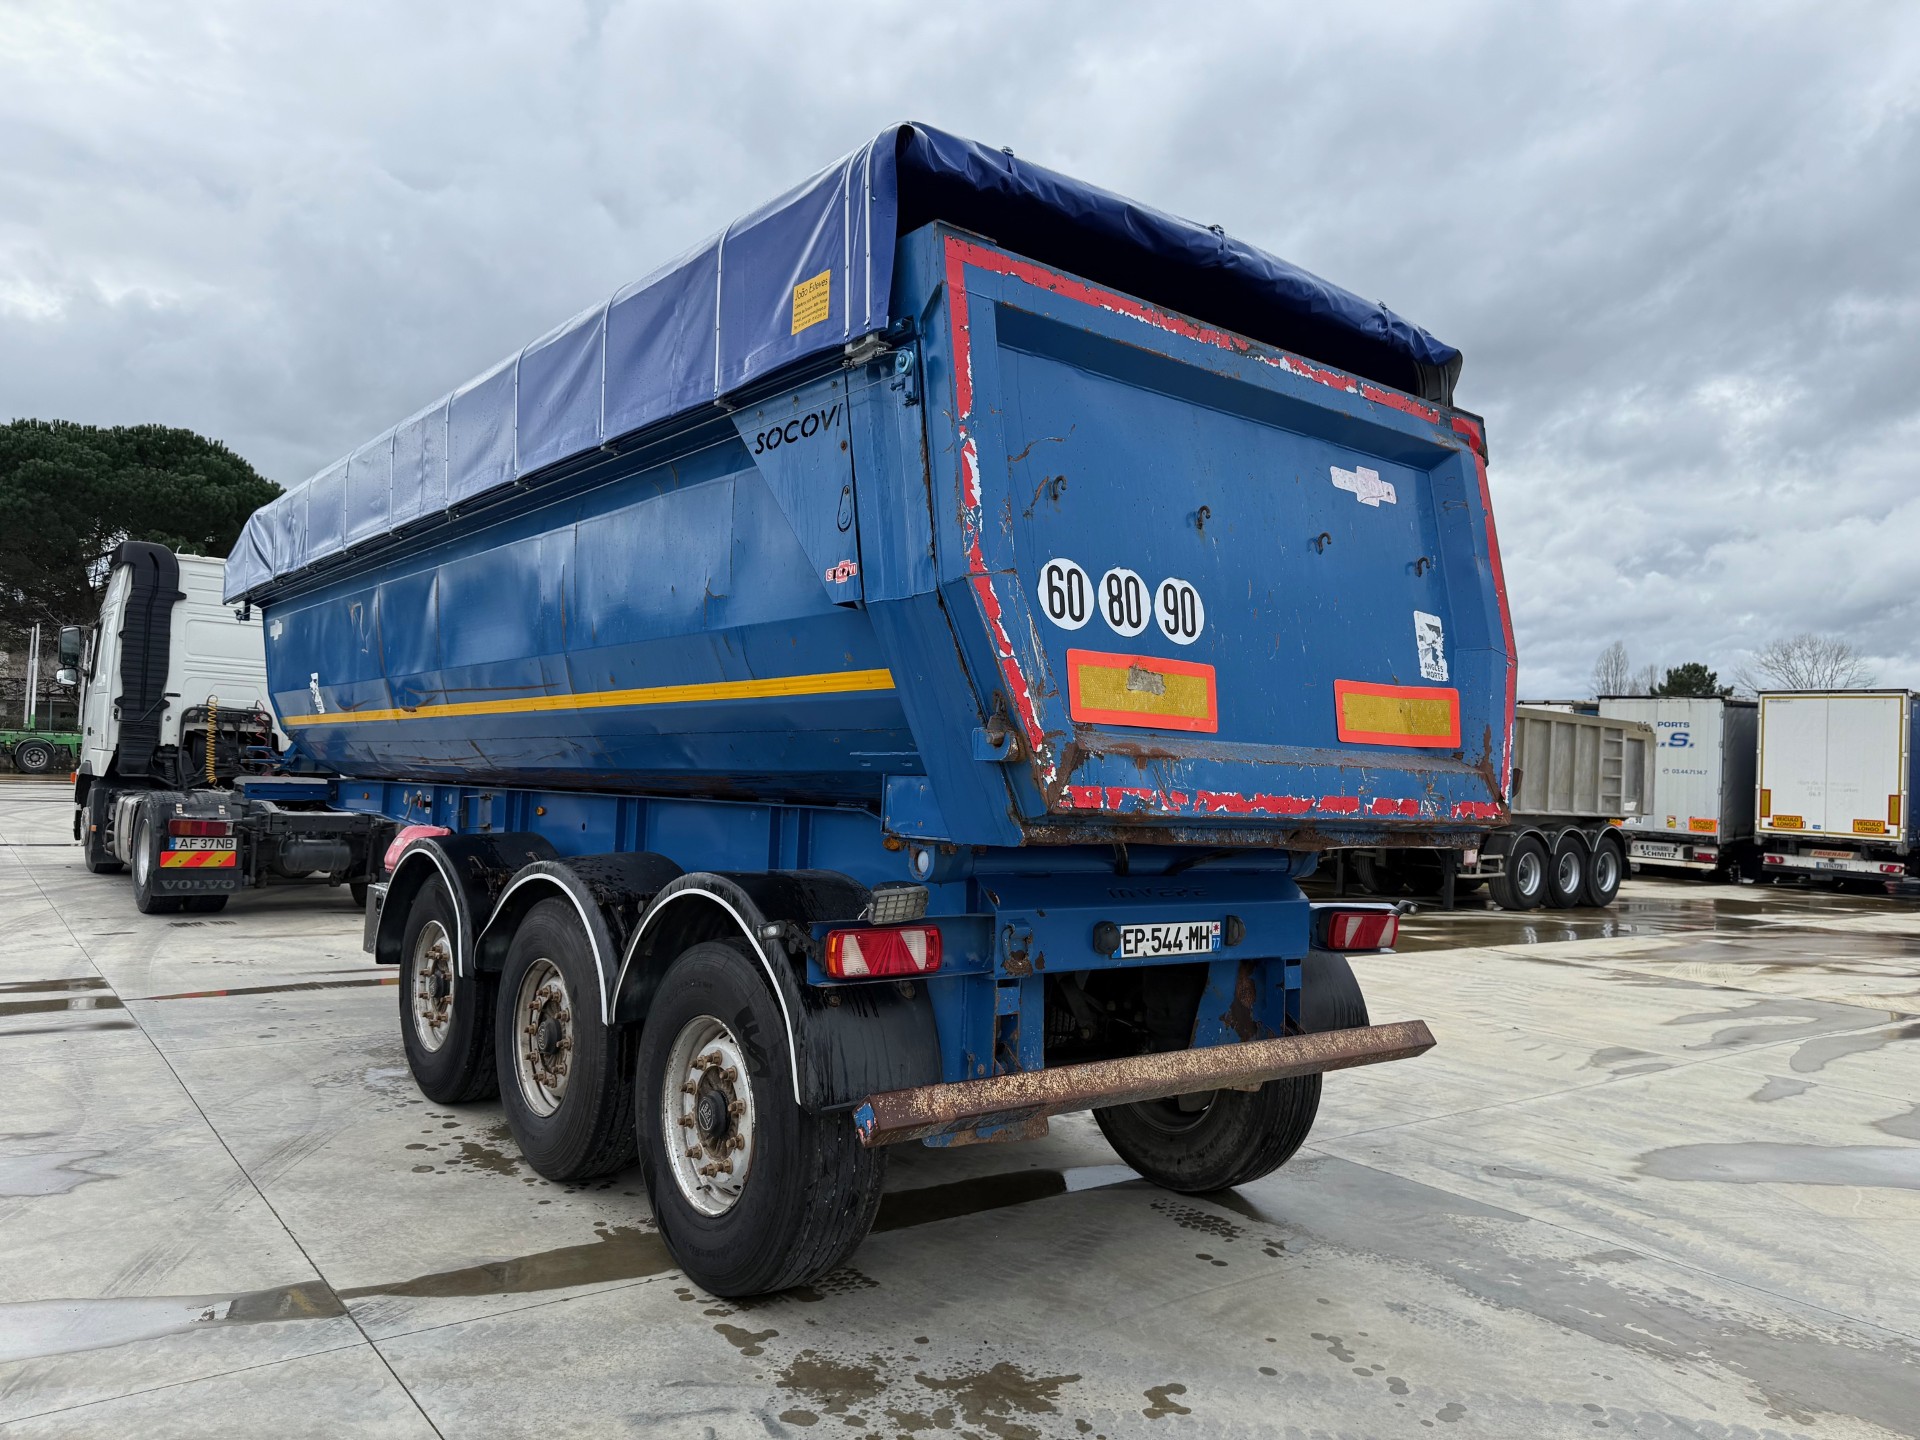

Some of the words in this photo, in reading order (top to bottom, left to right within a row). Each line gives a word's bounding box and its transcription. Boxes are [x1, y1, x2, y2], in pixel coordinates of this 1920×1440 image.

[755, 402, 843, 455] SOCOVI
[827, 564, 856, 580] SCOVI
[1047, 564, 1085, 622] 60
[1106, 573, 1142, 629] 80
[1162, 583, 1197, 638] 90
[1424, 661, 1444, 673] ANGLES
[1426, 669, 1444, 681] MORTS
[1642, 850, 1677, 859] SCHMITZ
[161, 880, 235, 890] VOLVO
[1123, 926, 1209, 955] EP-544-MH
[1212, 937, 1221, 949] 77
